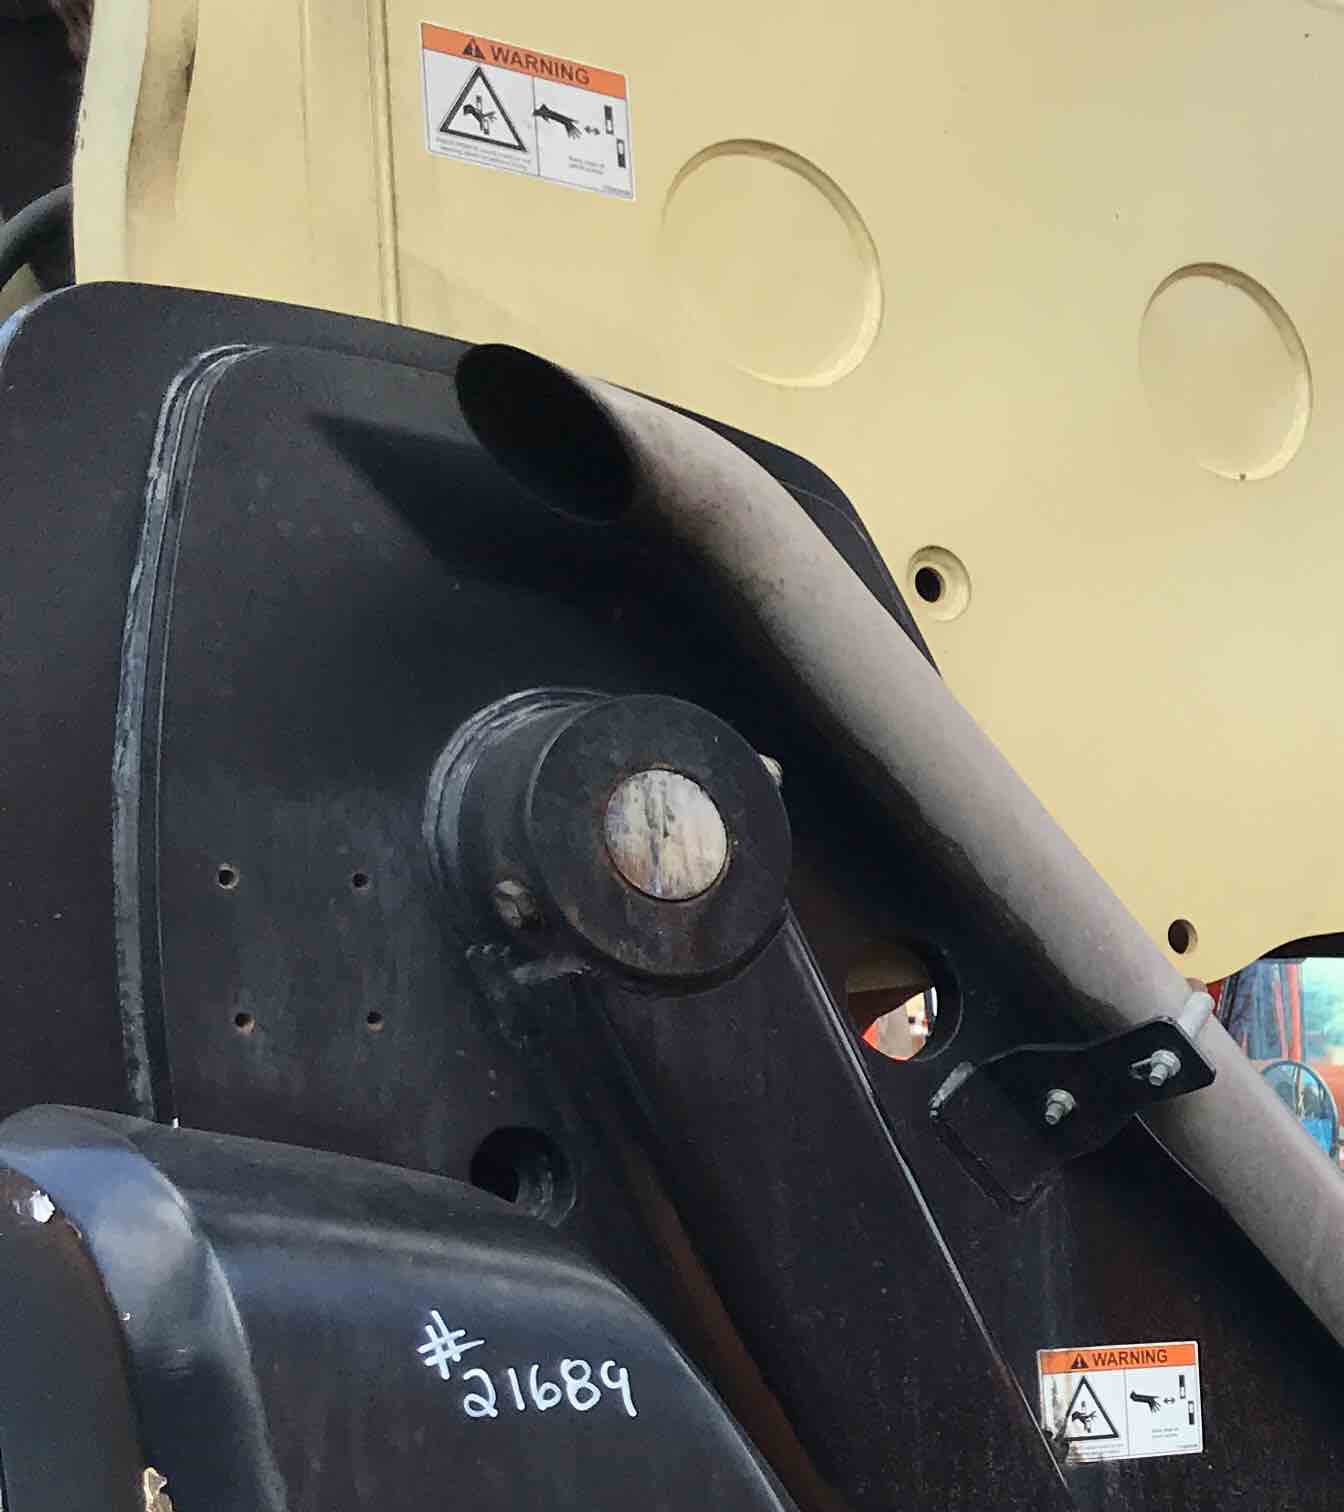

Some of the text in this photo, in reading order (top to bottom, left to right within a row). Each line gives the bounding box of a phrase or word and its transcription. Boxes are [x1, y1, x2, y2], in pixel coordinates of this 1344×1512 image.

[490, 44, 590, 86] WARNING
[416, 1309, 638, 1418] # 21689
[1092, 1349, 1168, 1367] WARNING
